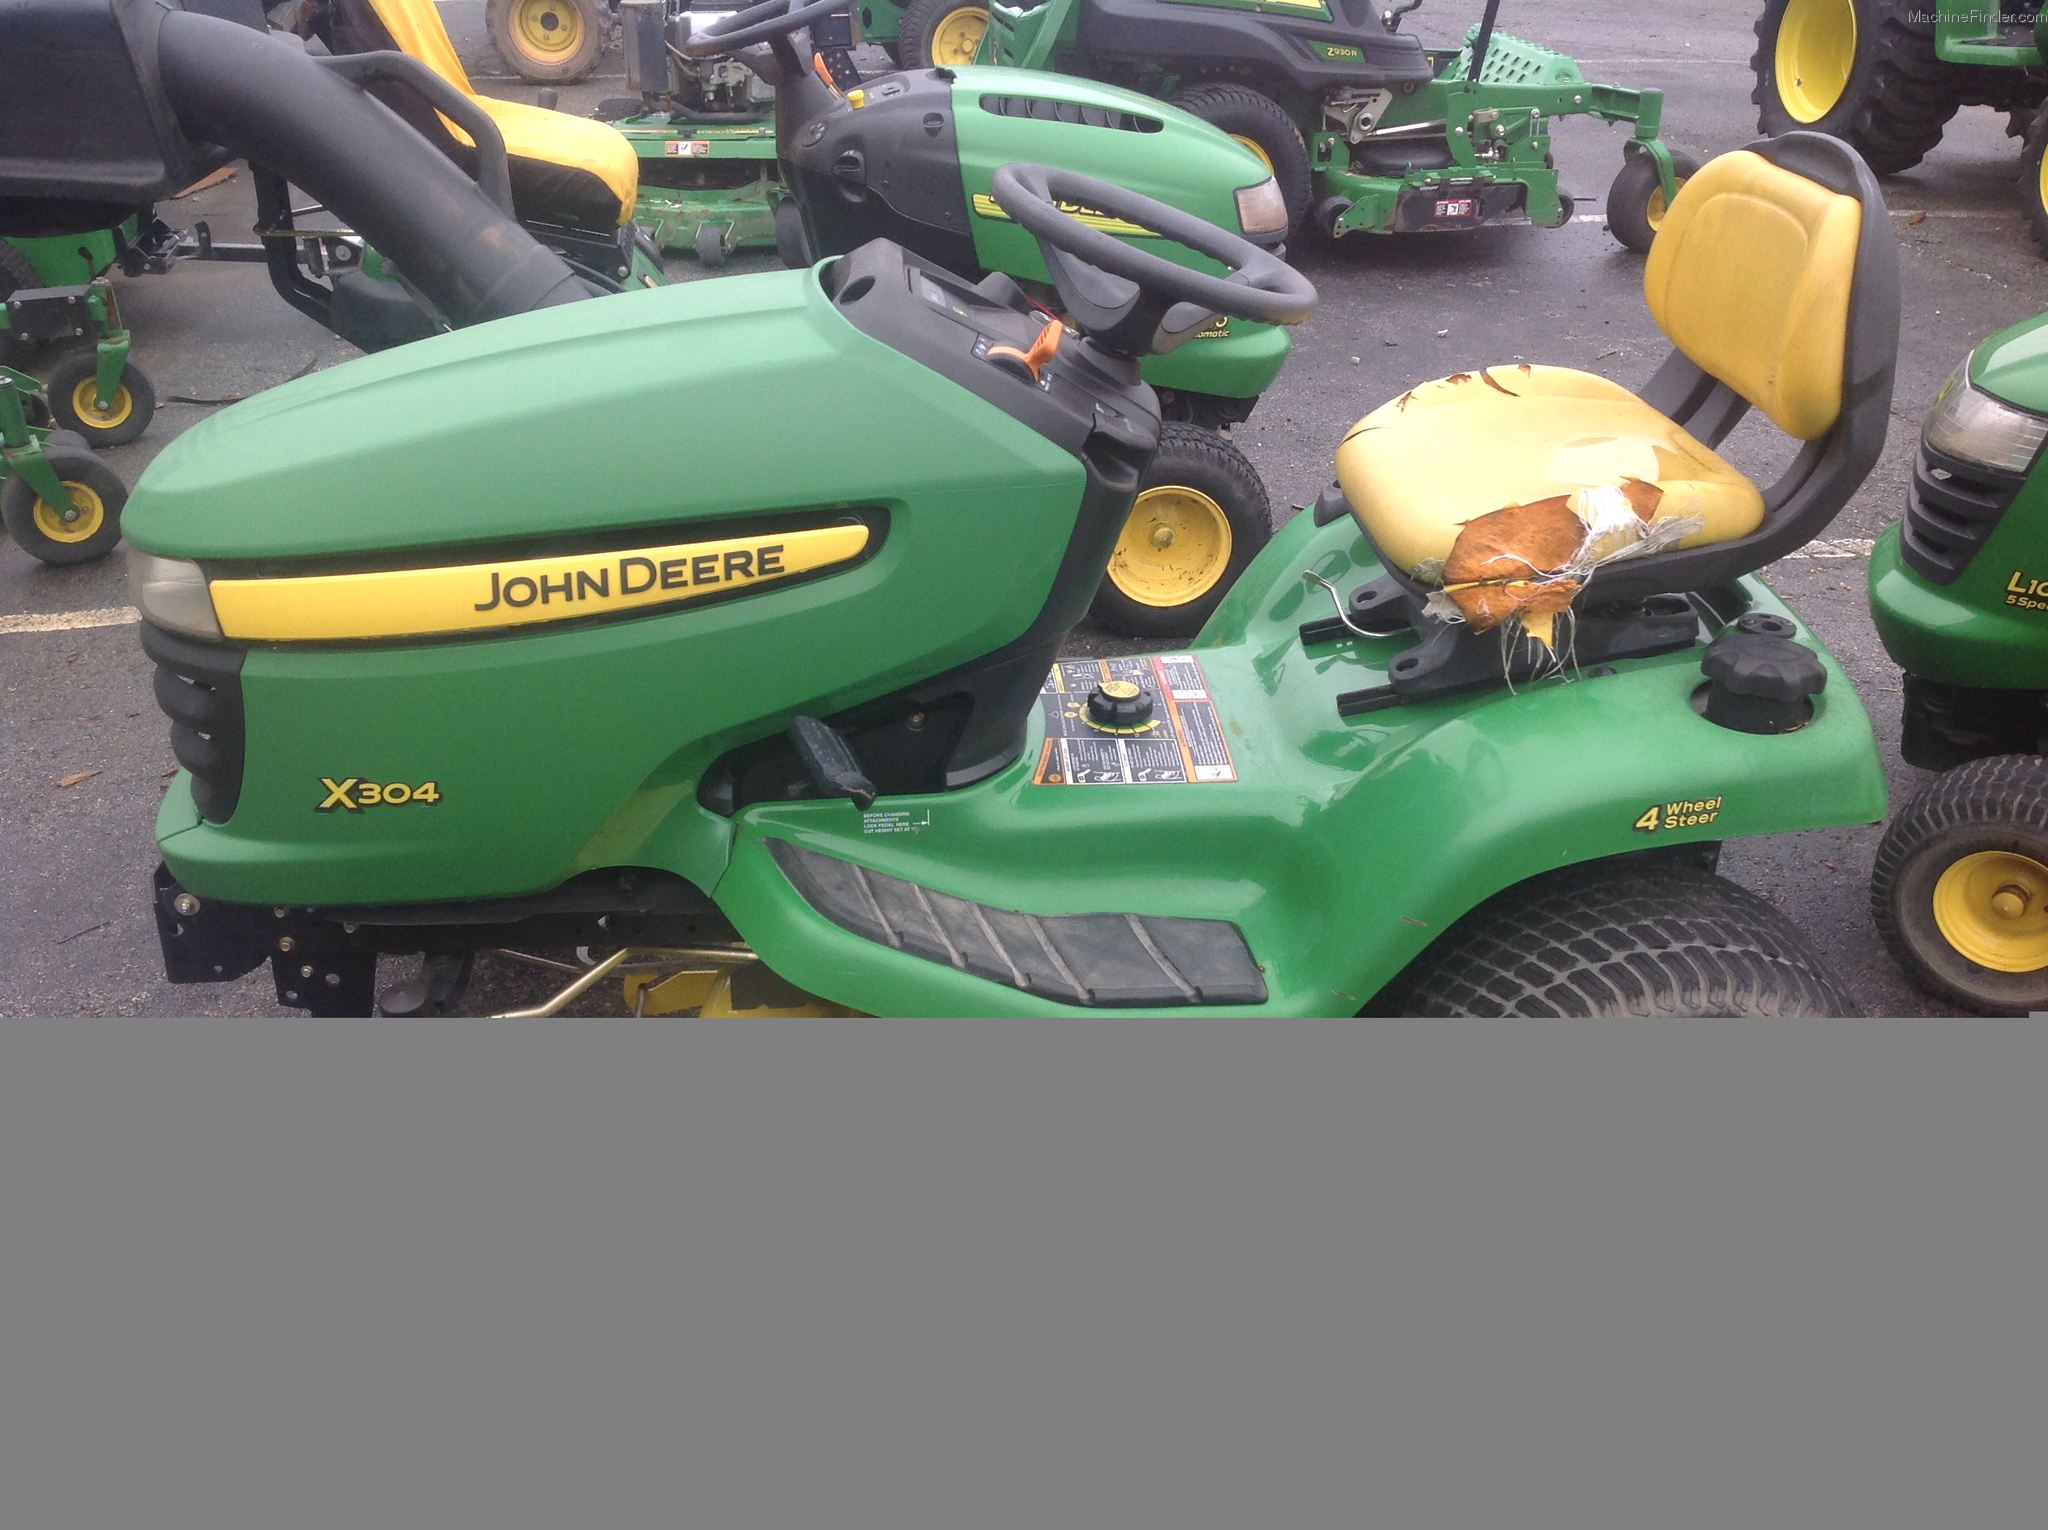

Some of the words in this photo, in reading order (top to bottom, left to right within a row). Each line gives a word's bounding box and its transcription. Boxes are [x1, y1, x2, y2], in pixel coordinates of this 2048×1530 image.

[1194, 328, 1230, 339] omatic
[474, 568, 610, 611] JOHN
[619, 544, 786, 595] DEERE
[2006, 594, 2017, 604] 5
[2016, 596, 2048, 609] Spe
[317, 777, 441, 810] X304
[1666, 795, 1723, 816] Wheel
[1635, 806, 1659, 831] 4
[1663, 811, 1719, 830] Steer
